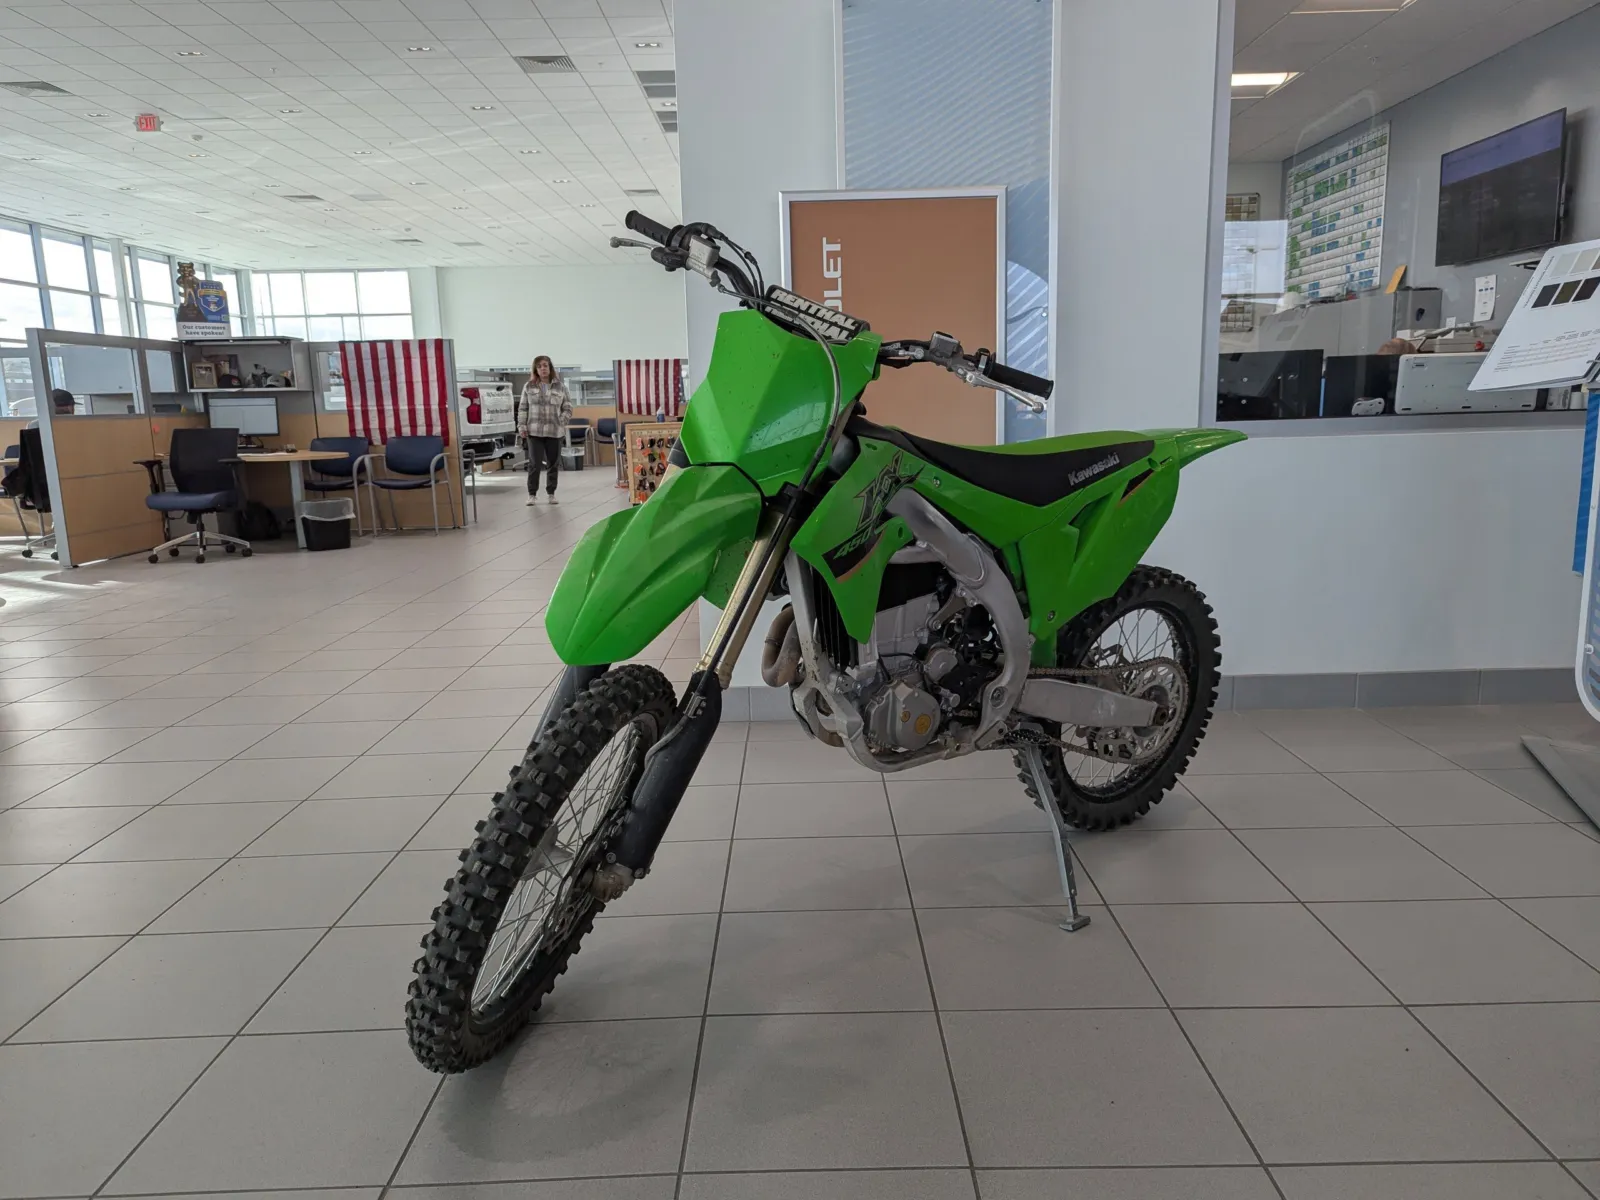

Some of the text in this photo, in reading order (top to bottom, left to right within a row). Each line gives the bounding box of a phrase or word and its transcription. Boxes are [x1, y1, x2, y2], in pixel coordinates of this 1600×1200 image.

[138, 115, 157, 131] EXIT
[770, 288, 859, 331] RENTHAL
[1067, 451, 1120, 487] Kawasaki
